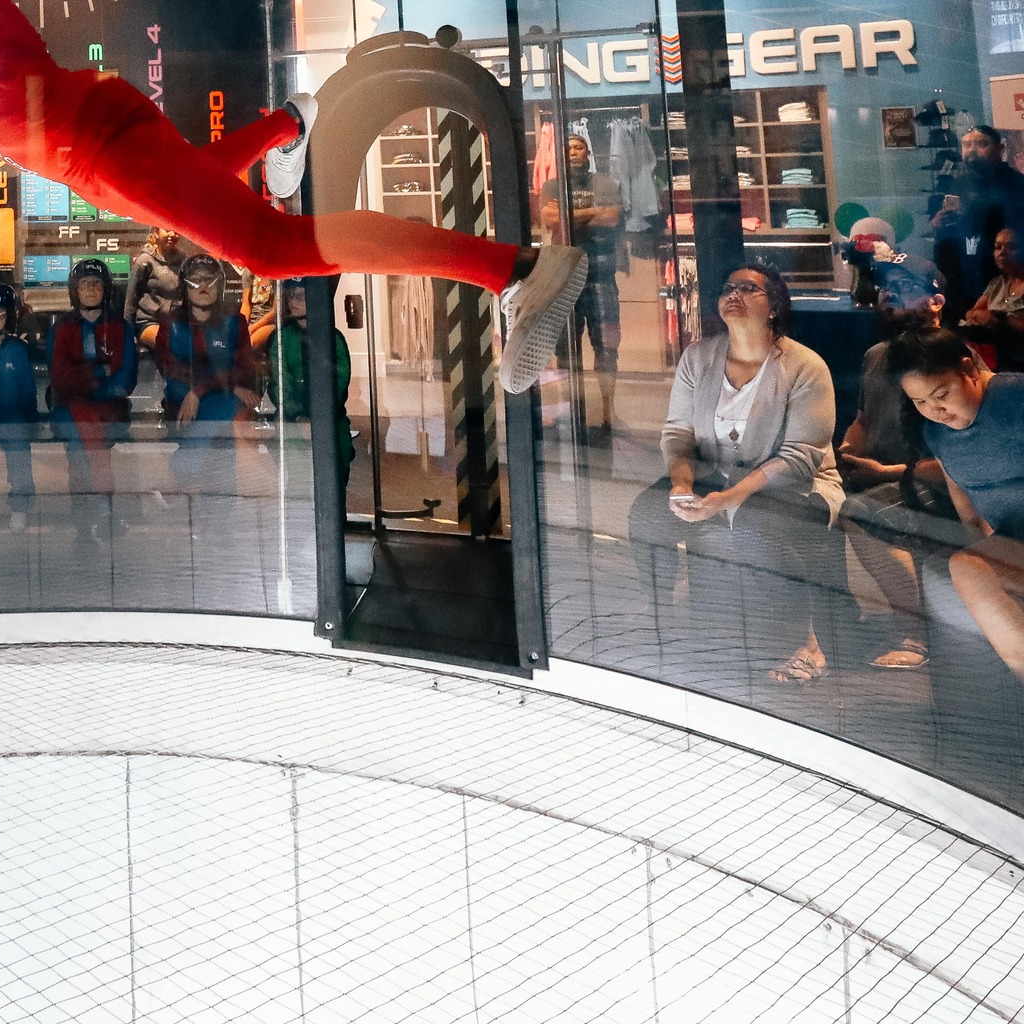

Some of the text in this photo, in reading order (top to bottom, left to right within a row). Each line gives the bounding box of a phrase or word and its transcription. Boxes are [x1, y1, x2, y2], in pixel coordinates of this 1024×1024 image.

[146, 23, 162, 45] 4
[58, 226, 80, 238] FF
[96, 238, 119, 251] FS
